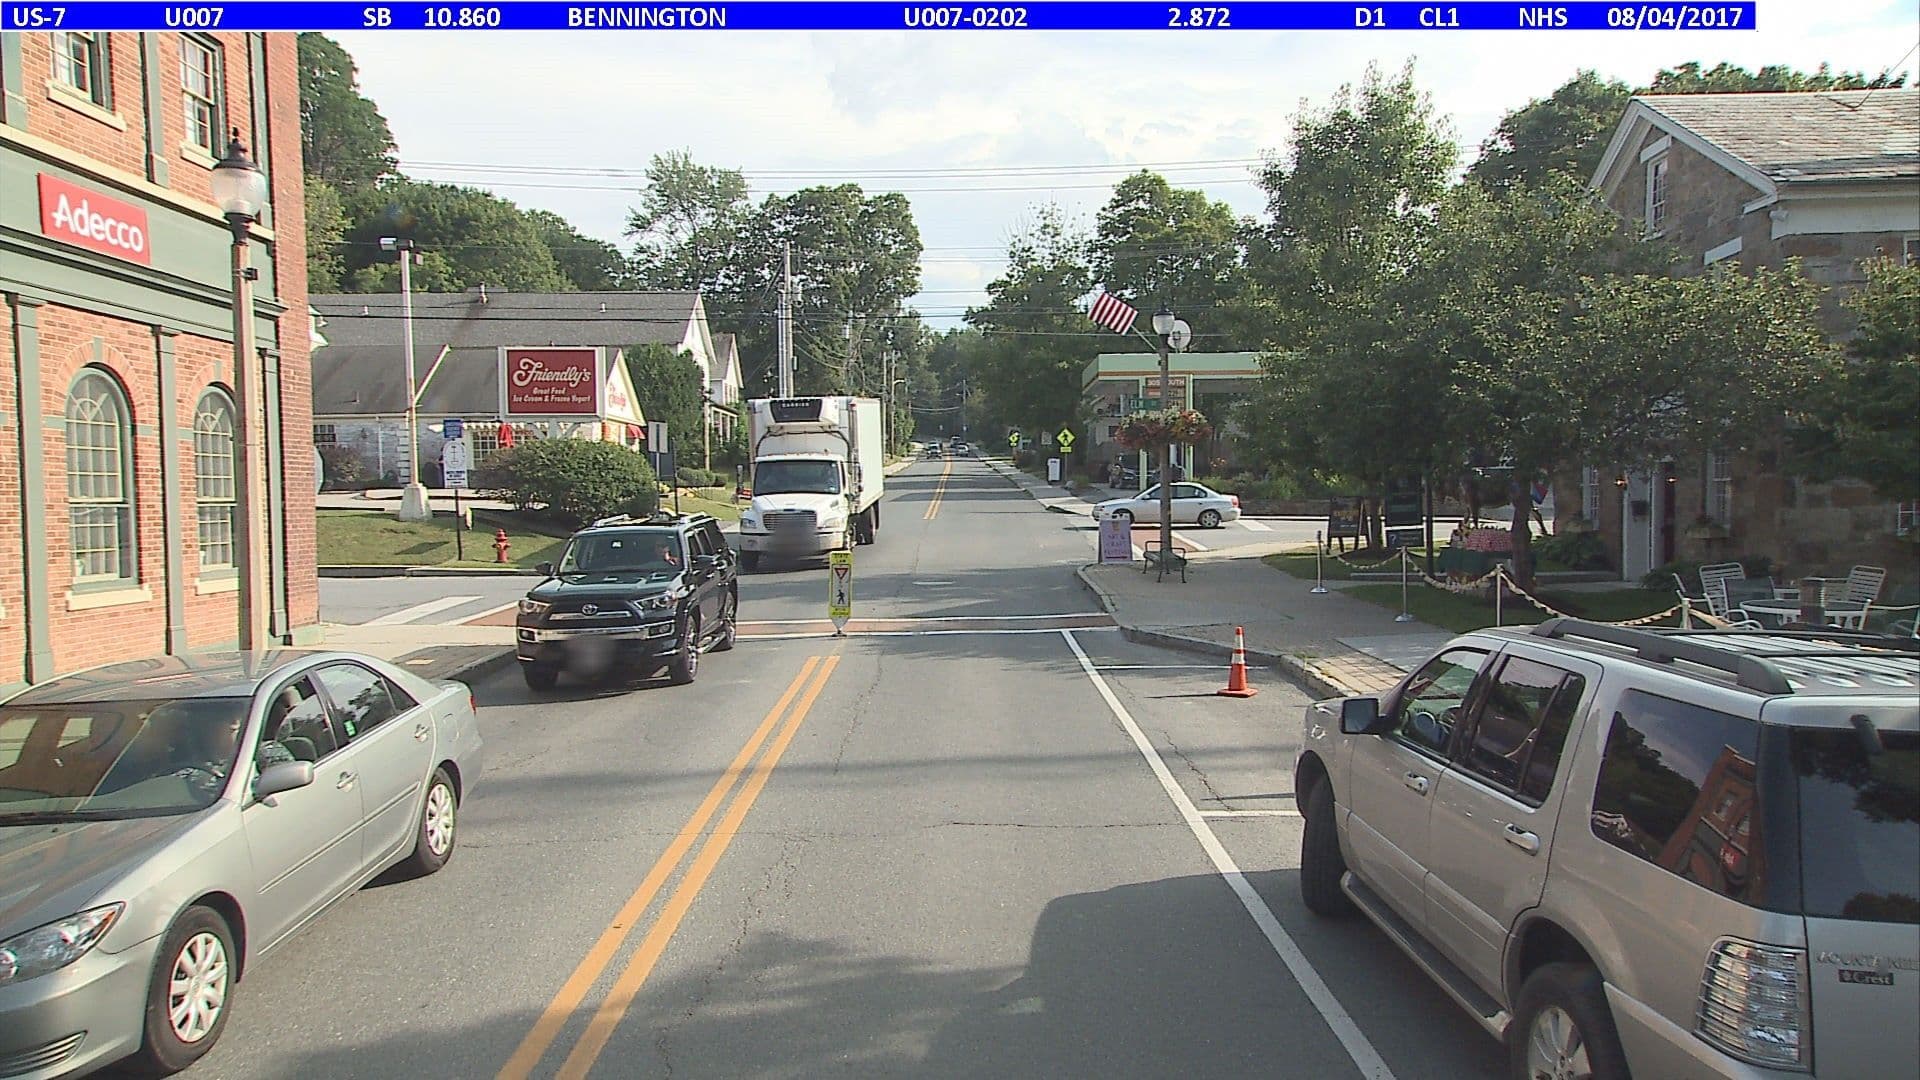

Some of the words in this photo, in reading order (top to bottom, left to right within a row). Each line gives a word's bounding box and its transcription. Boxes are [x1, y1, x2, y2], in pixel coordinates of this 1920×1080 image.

[51, 193, 144, 253] Adecco
[512, 358, 592, 387] Friendly's
[533, 387, 550, 395] Great
[571, 395, 591, 403] Yogurt
